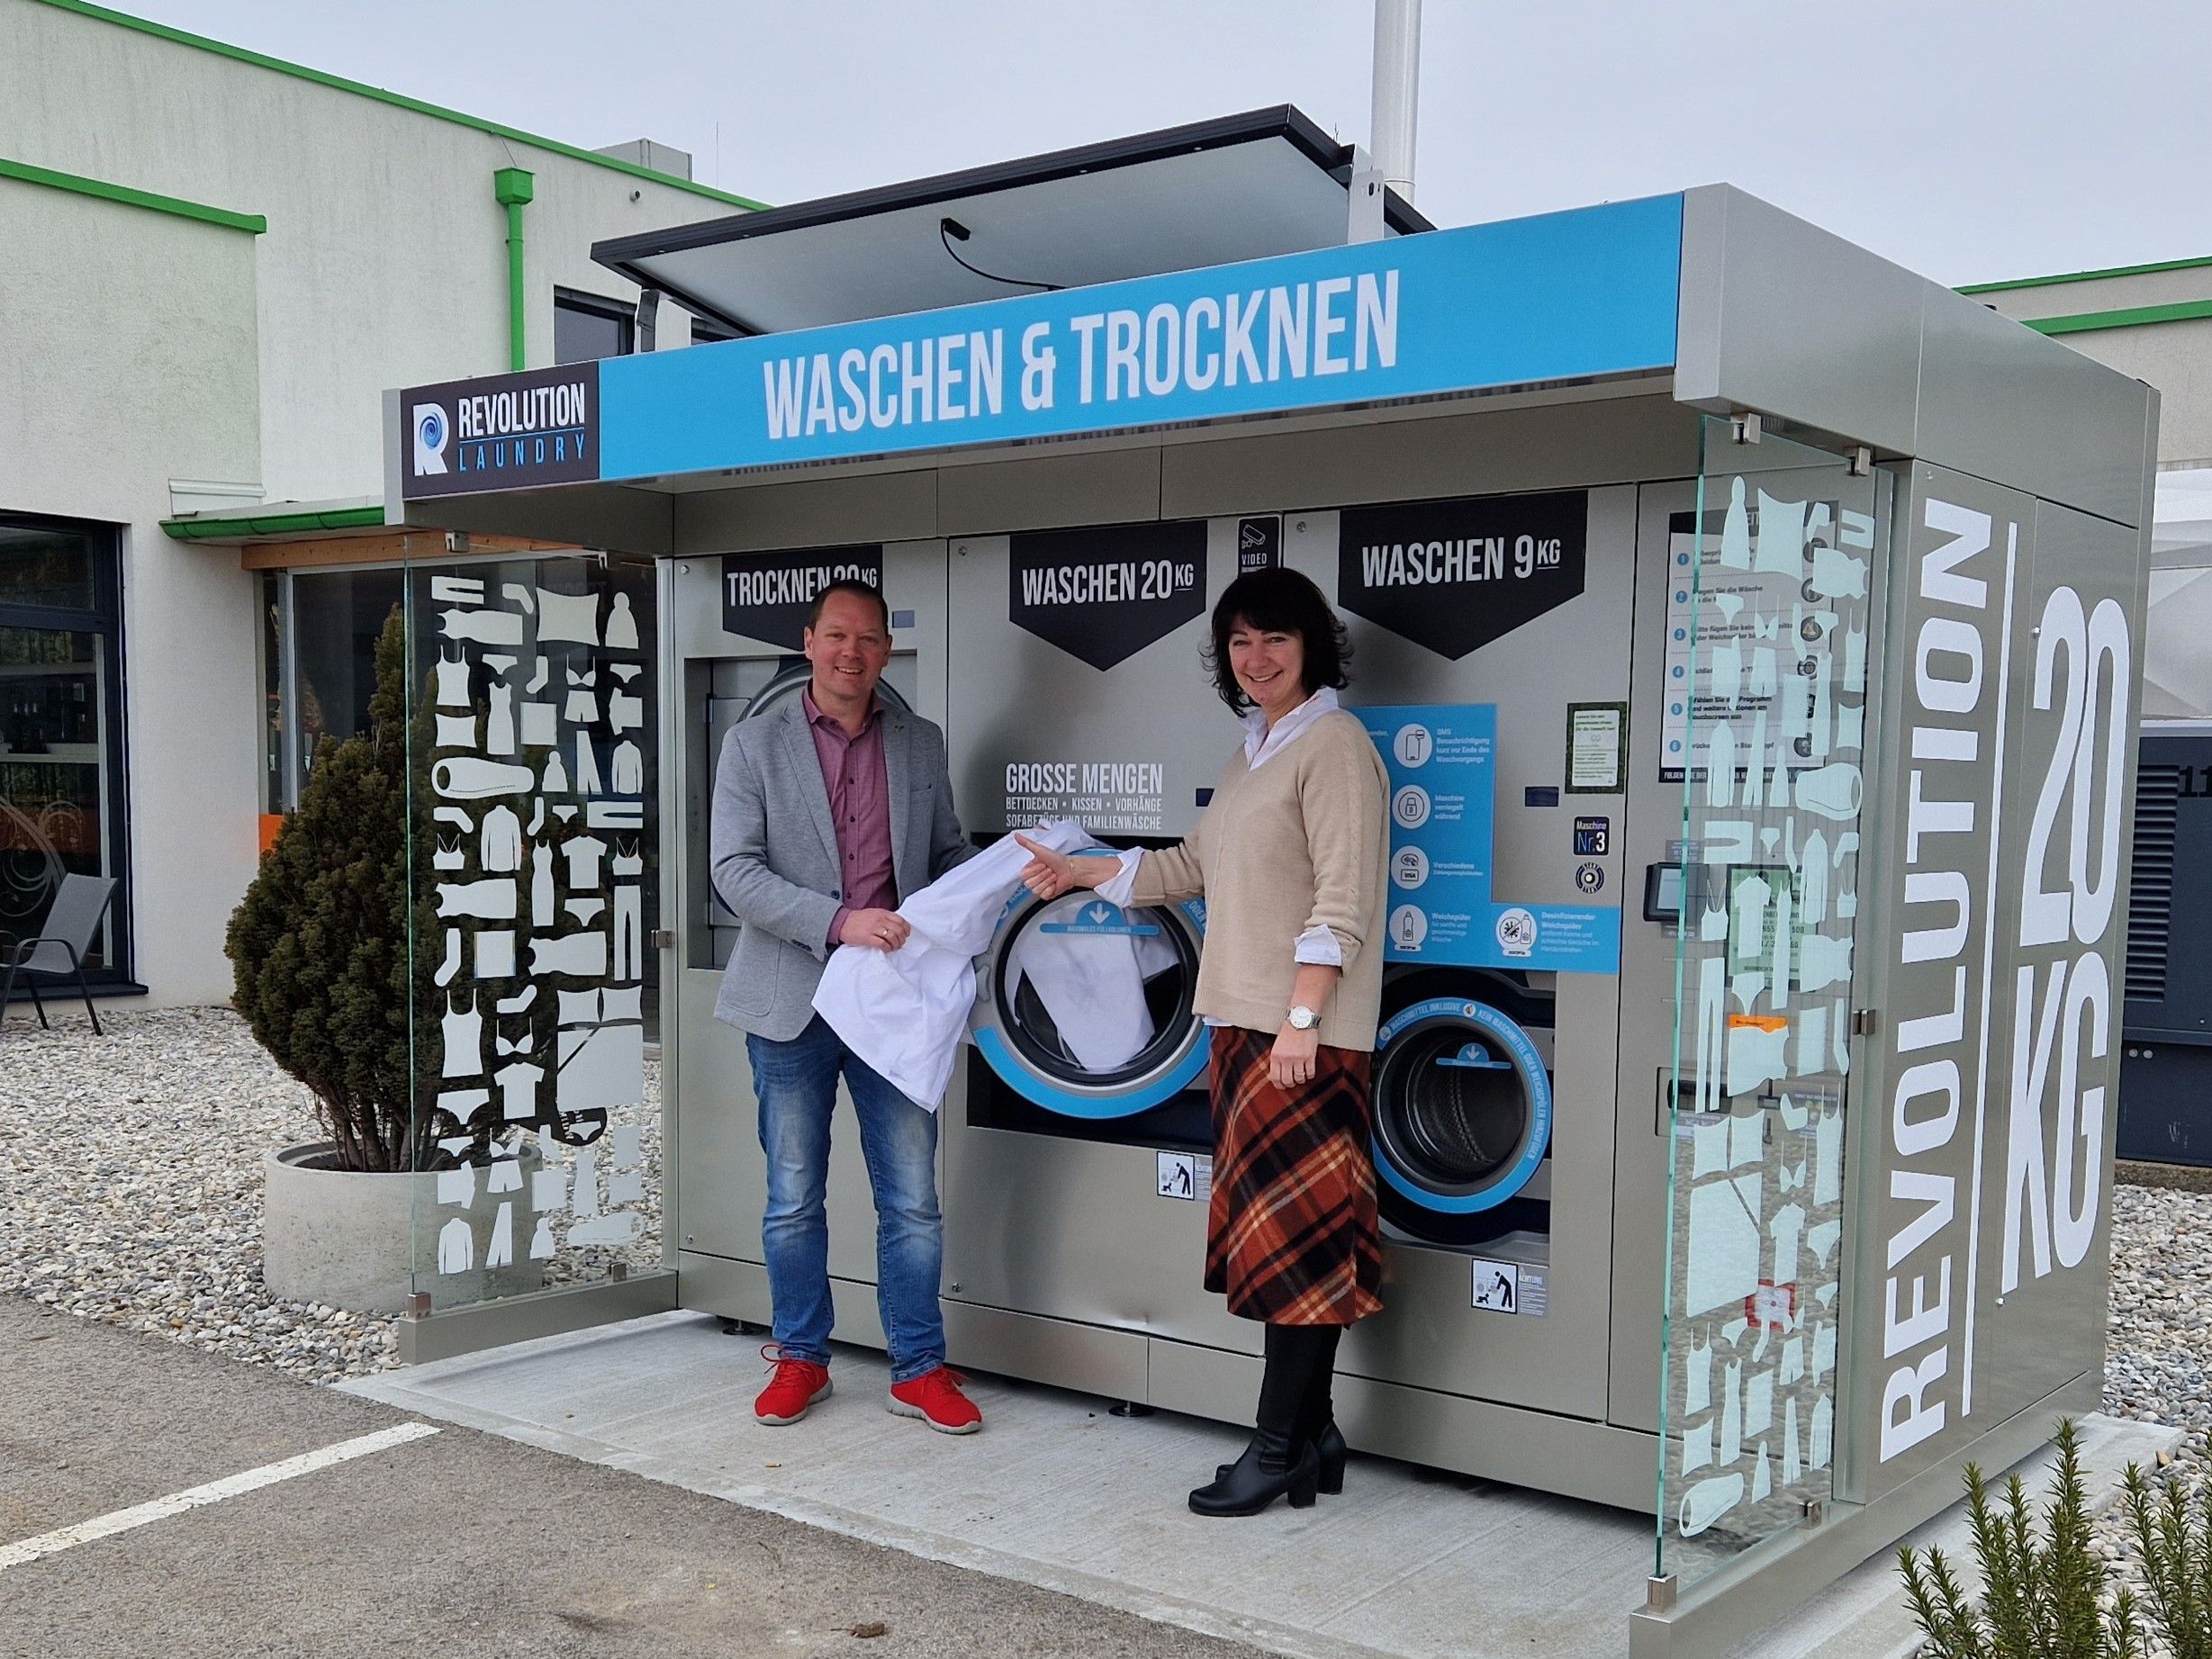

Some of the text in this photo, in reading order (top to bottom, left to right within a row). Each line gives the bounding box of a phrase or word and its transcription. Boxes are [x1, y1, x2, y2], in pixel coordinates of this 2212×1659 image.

[763, 268, 1400, 440] WASCHEN & TROCKNEN
[457, 382, 586, 438] REVOLUTION
[458, 433, 585, 473] LAUNDRY
[1241, 553, 1268, 566] VIDEO
[1362, 536, 1504, 588] WASCHEN
[727, 565, 831, 608] TROCKNEN
[1022, 562, 1136, 606] WASCHEN
[1006, 762, 1163, 795] GROSSE MENGEN
[2018, 585, 2130, 948] 20
[1006, 795, 1161, 813] BETTDECKEN KISSEN VORHÄNGE
[1082, 812, 1161, 830] FAMILIENWÄSCHE
[1576, 820, 1607, 830] Maschine
[1879, 496, 1992, 1464] REVOLUTION
[2001, 950, 2110, 1295] KG
